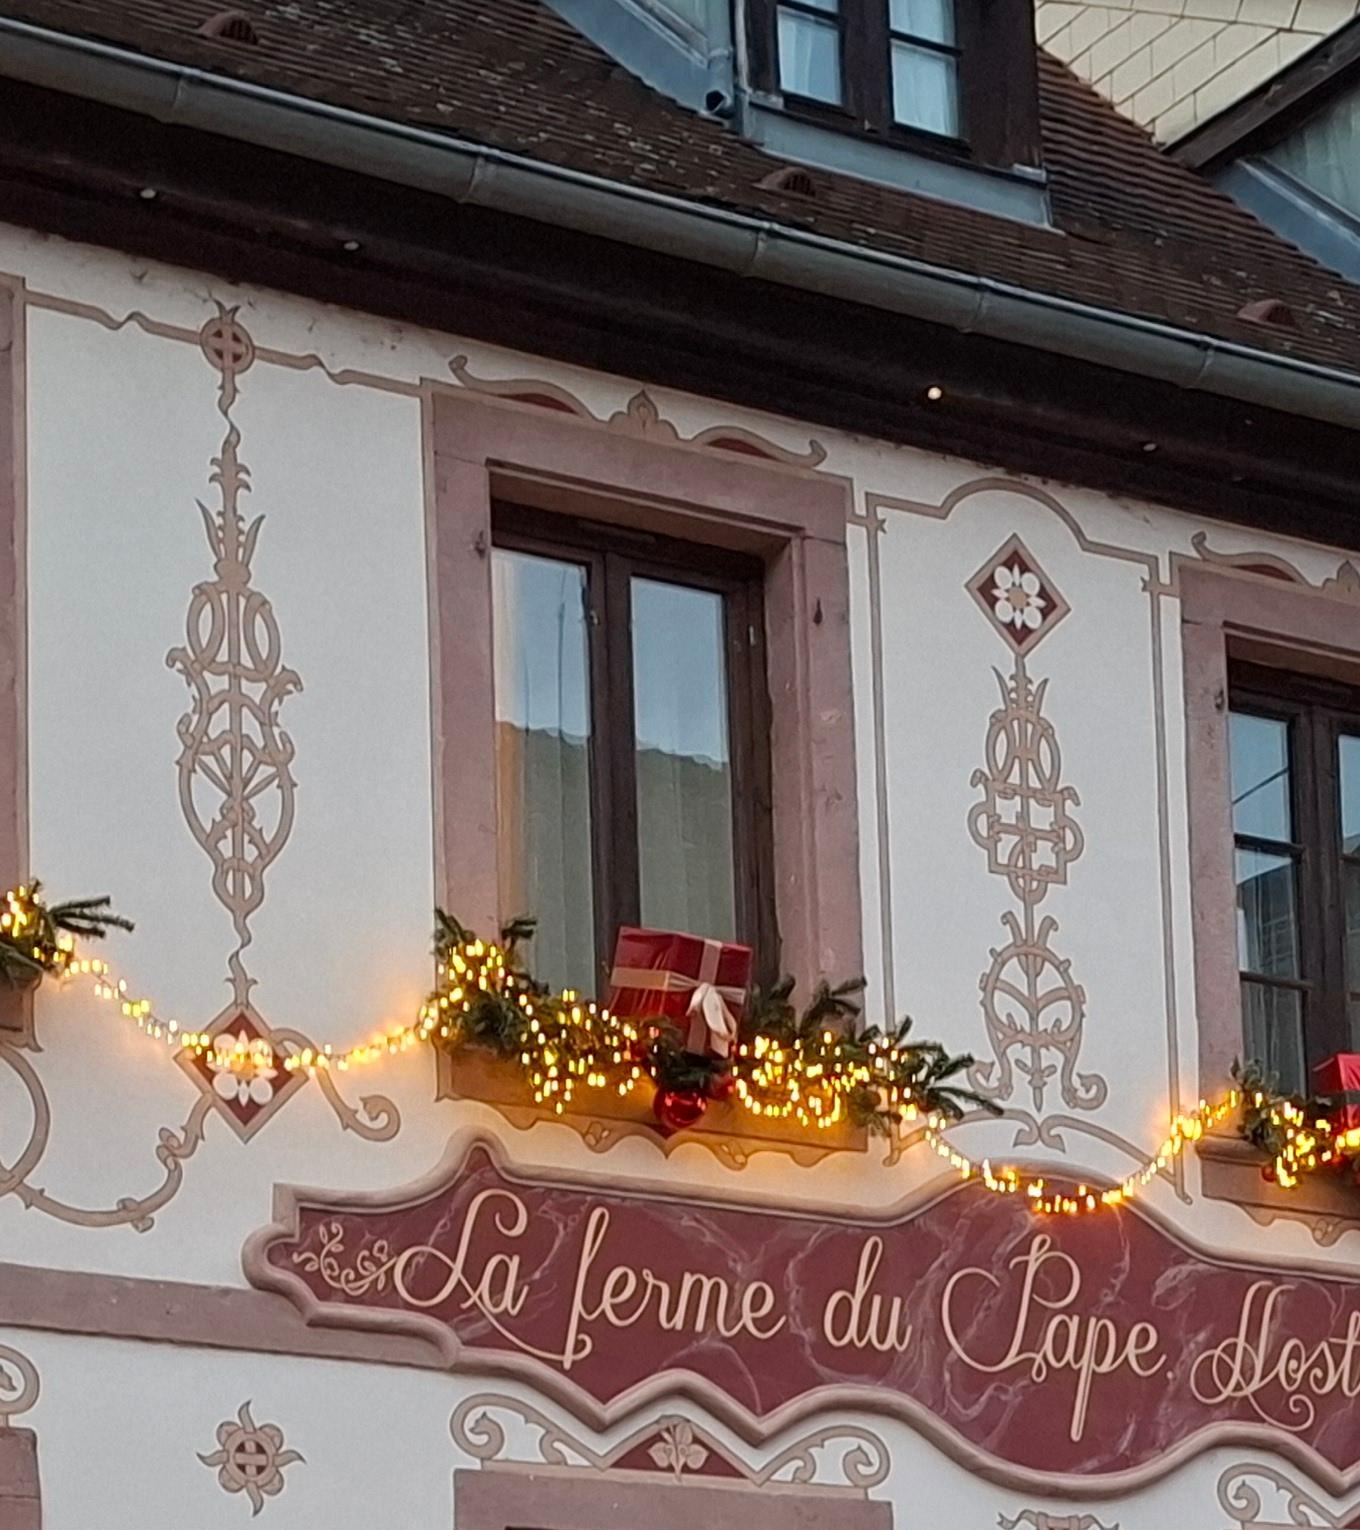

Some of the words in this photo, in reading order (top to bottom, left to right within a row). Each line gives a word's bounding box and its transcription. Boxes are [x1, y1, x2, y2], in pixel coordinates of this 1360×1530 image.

[394, 1188, 592, 1361] La
[562, 1206, 786, 1370] ferme
[823, 1236, 913, 1352] du
